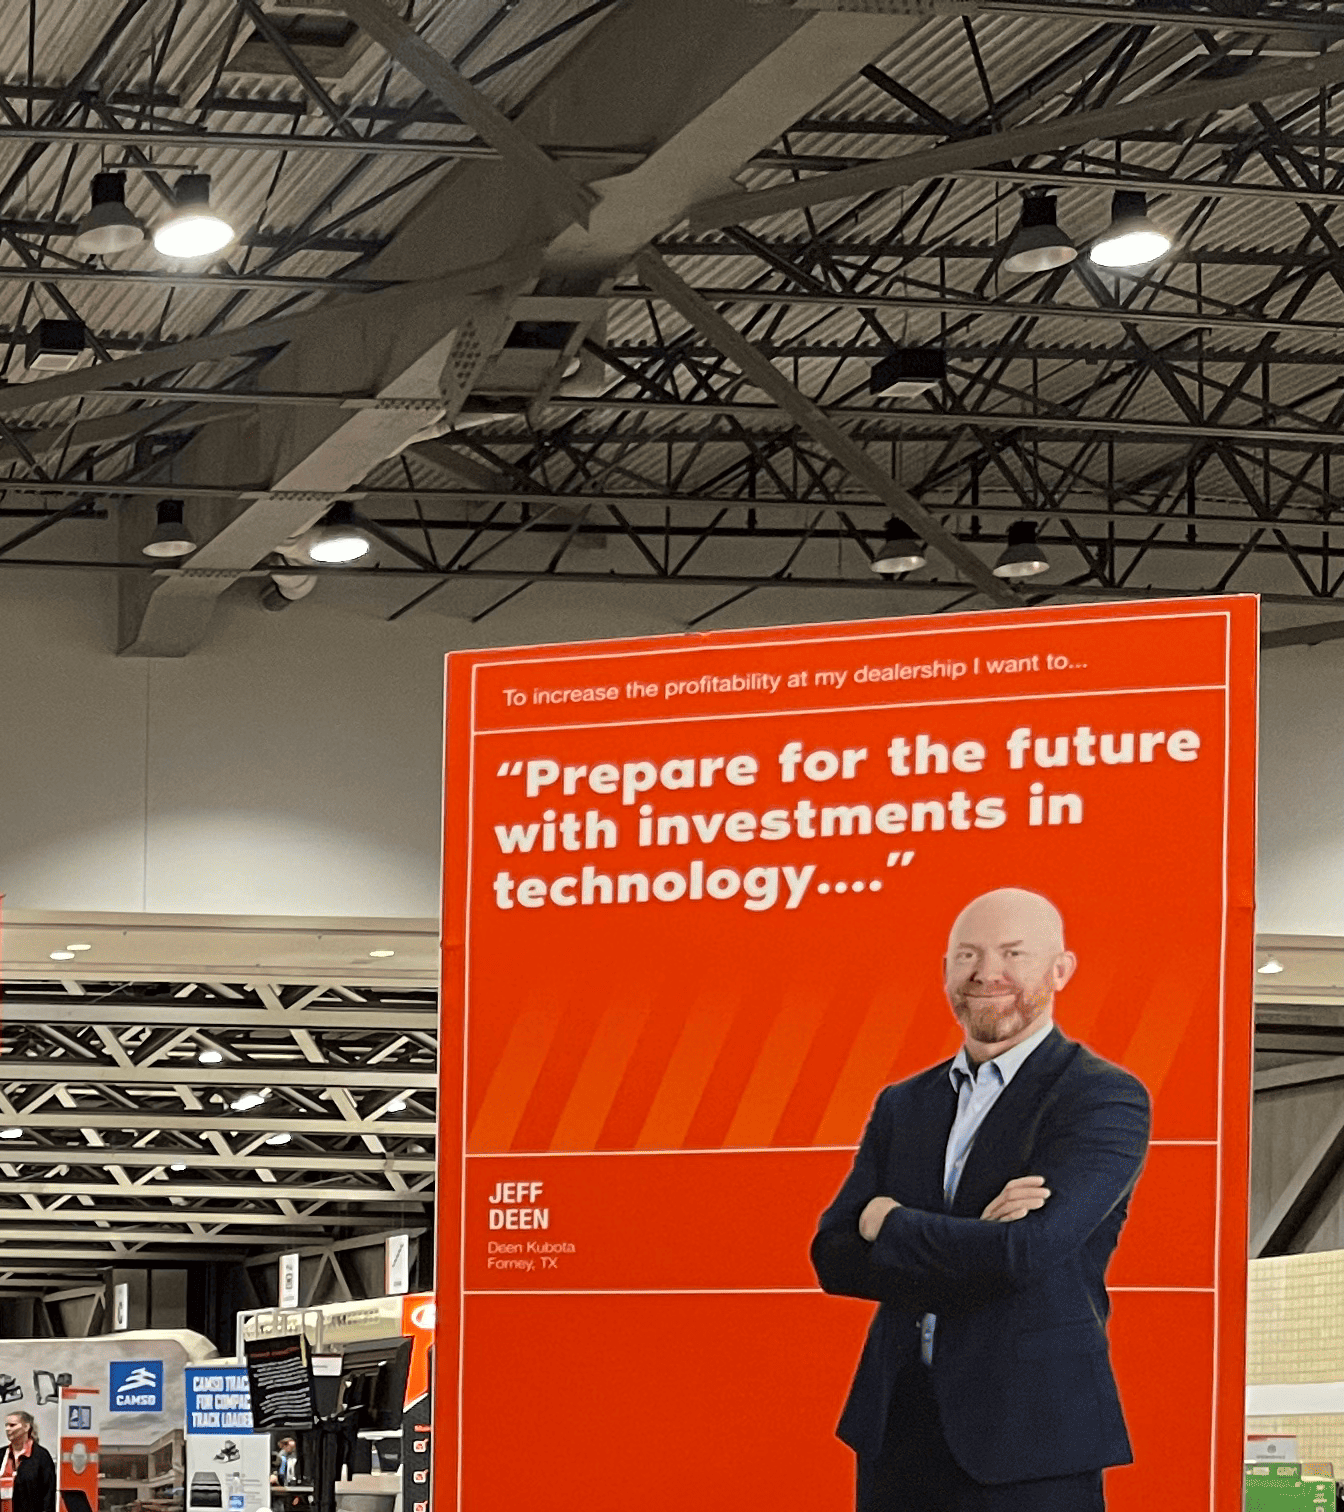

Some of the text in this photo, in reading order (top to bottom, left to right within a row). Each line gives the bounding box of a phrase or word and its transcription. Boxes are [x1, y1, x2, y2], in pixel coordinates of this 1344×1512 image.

[503, 689, 526, 706] To
[533, 687, 619, 704] increase
[626, 682, 658, 698] the
[665, 673, 781, 699] profitability
[788, 672, 807, 687] at
[815, 671, 847, 689] my
[854, 659, 967, 683] dealership
[974, 658, 978, 674] I
[987, 656, 1038, 673] want
[779, 742, 867, 782] for
[888, 735, 985, 776] the
[1007, 727, 1200, 769] future
[495, 782, 1082, 853] with investments in
[488, 1182, 543, 1204] JEFF
[489, 1208, 549, 1230] DEEN
[488, 1241, 575, 1254] Deen Kubota
[540, 1257, 558, 1268] TX
[116, 1394, 156, 1406] CAMSO
[196, 1394, 213, 1410] FOR
[192, 1412, 220, 1427] TRACK
